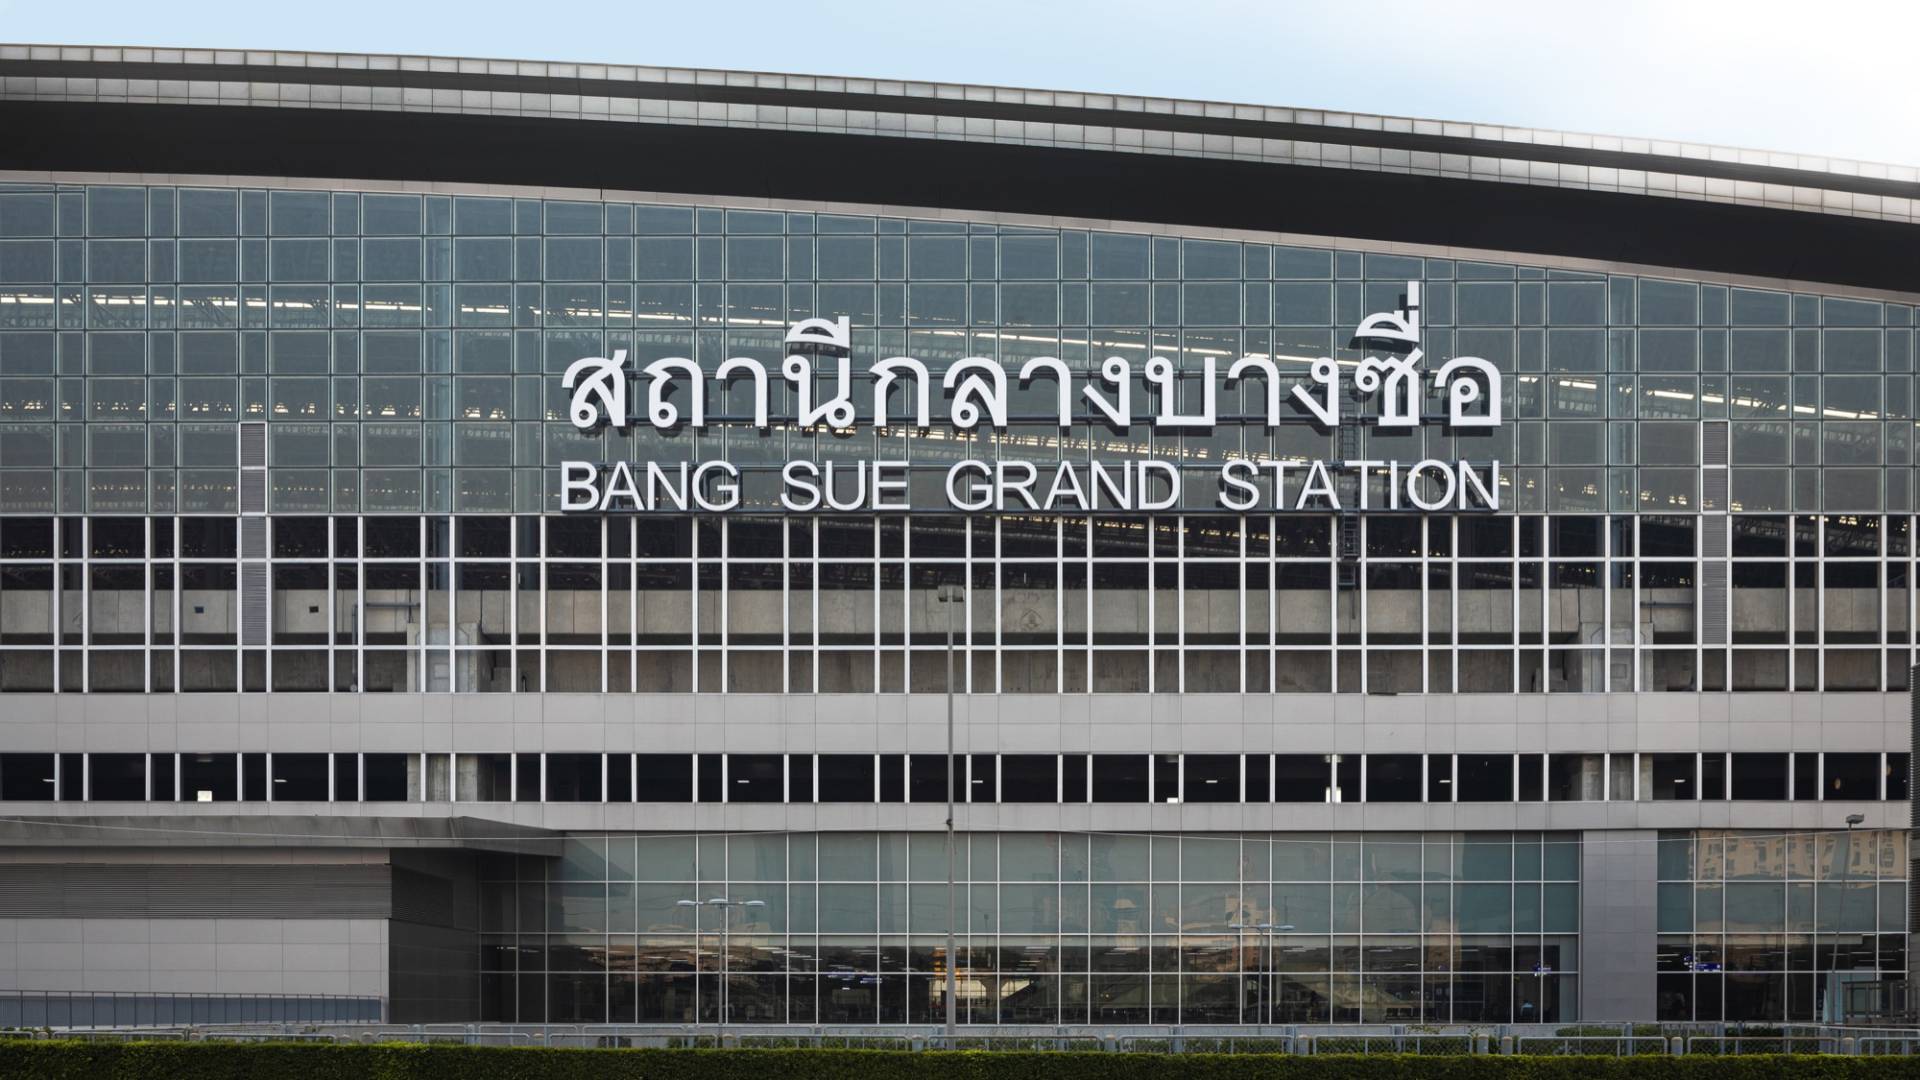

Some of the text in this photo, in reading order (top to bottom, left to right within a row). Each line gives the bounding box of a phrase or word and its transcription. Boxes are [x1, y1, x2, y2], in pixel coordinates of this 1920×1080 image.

[561, 282, 1502, 428] สถานีกลางบางซื่อ
[560, 459, 1500, 511] BANG SUE GRAND STATION
